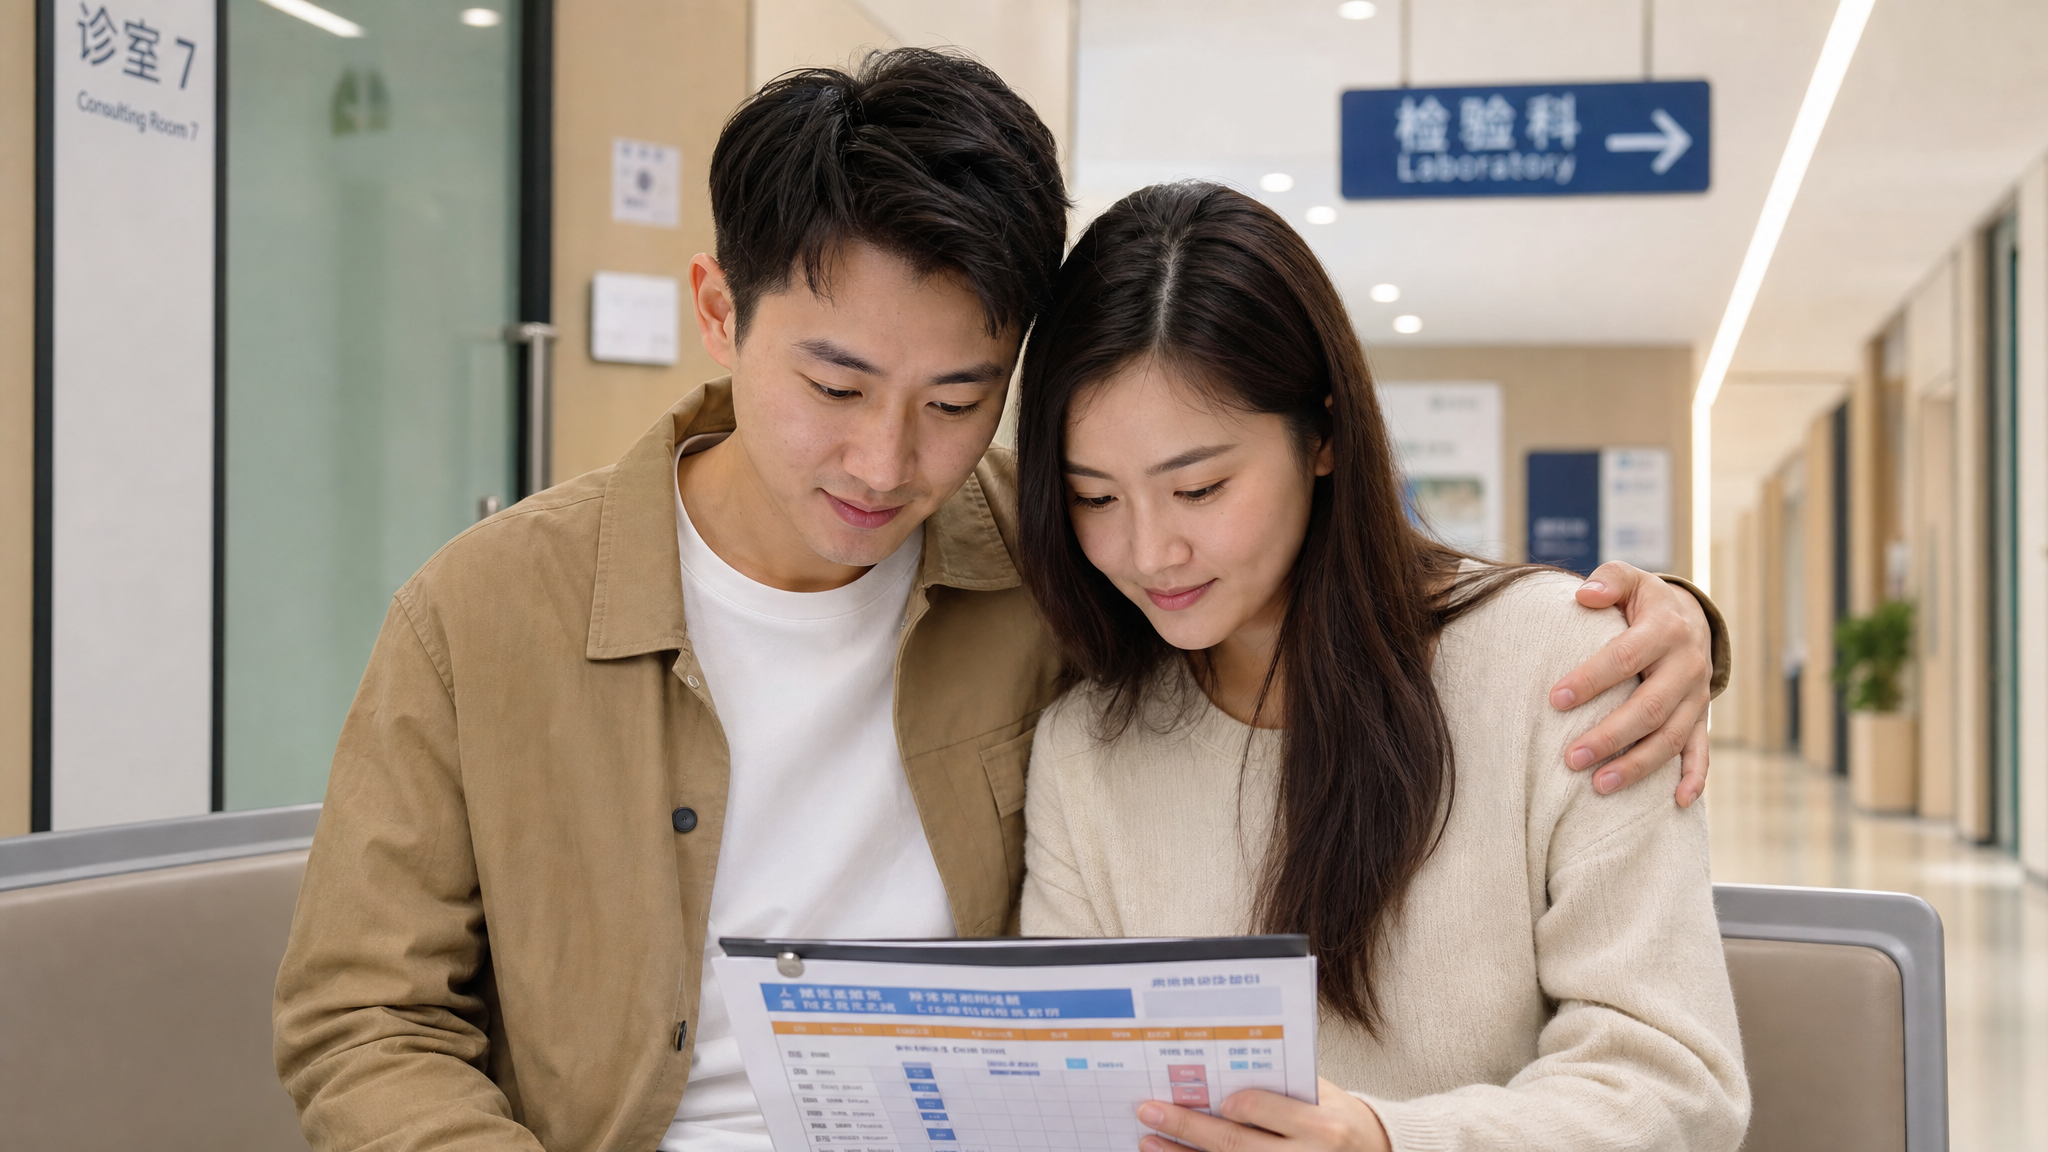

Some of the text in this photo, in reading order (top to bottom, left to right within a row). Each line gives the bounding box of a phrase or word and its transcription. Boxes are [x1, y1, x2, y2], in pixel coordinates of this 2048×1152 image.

[78, 2, 195, 89] 诊室 7
[77, 91, 199, 141] Consulting Room 7
[1395, 93, 1581, 152] 检验科
[1397, 152, 1576, 185] Laboratory
